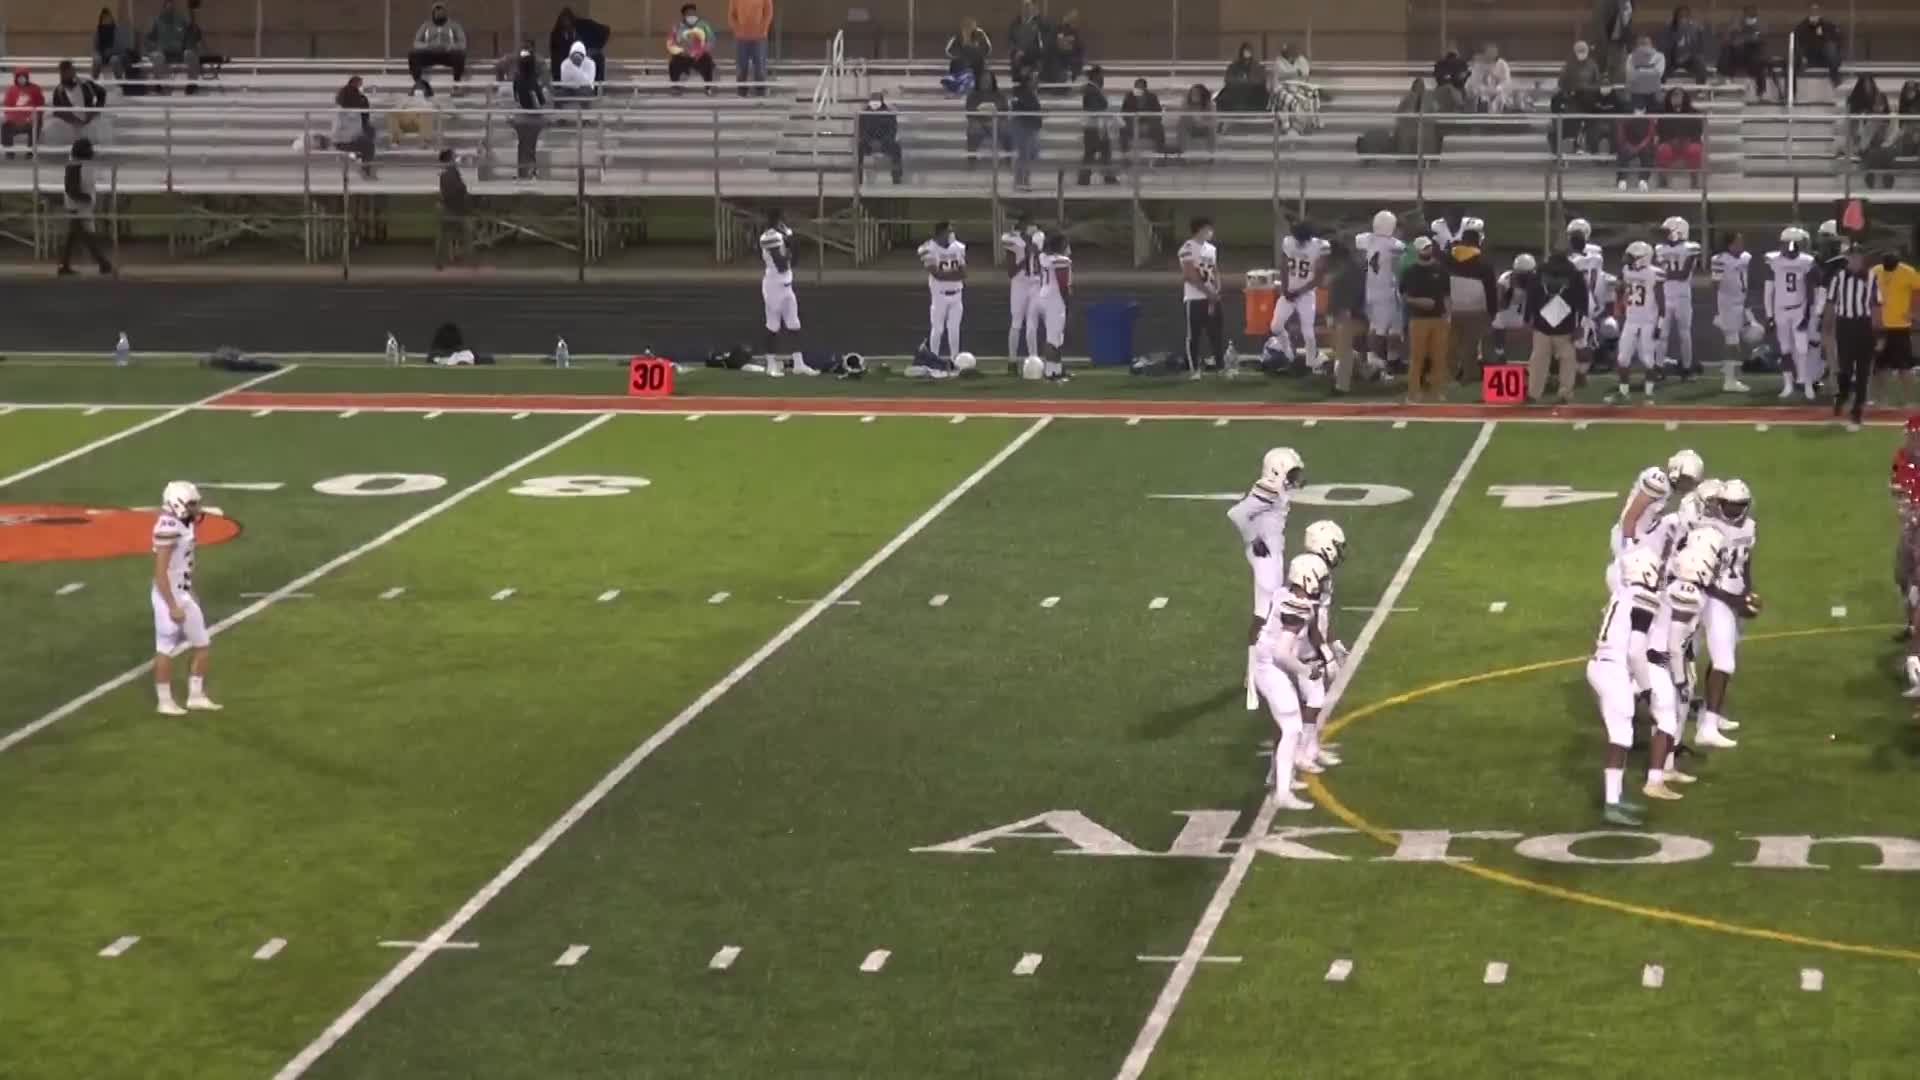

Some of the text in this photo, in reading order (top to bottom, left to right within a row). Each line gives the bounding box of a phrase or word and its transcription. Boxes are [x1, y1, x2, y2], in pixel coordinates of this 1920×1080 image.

[1785, 272, 1797, 293] 9
[633, 363, 665, 391] 30
[1488, 370, 1520, 397] 40
[908, 810, 1920, 871] Akron
